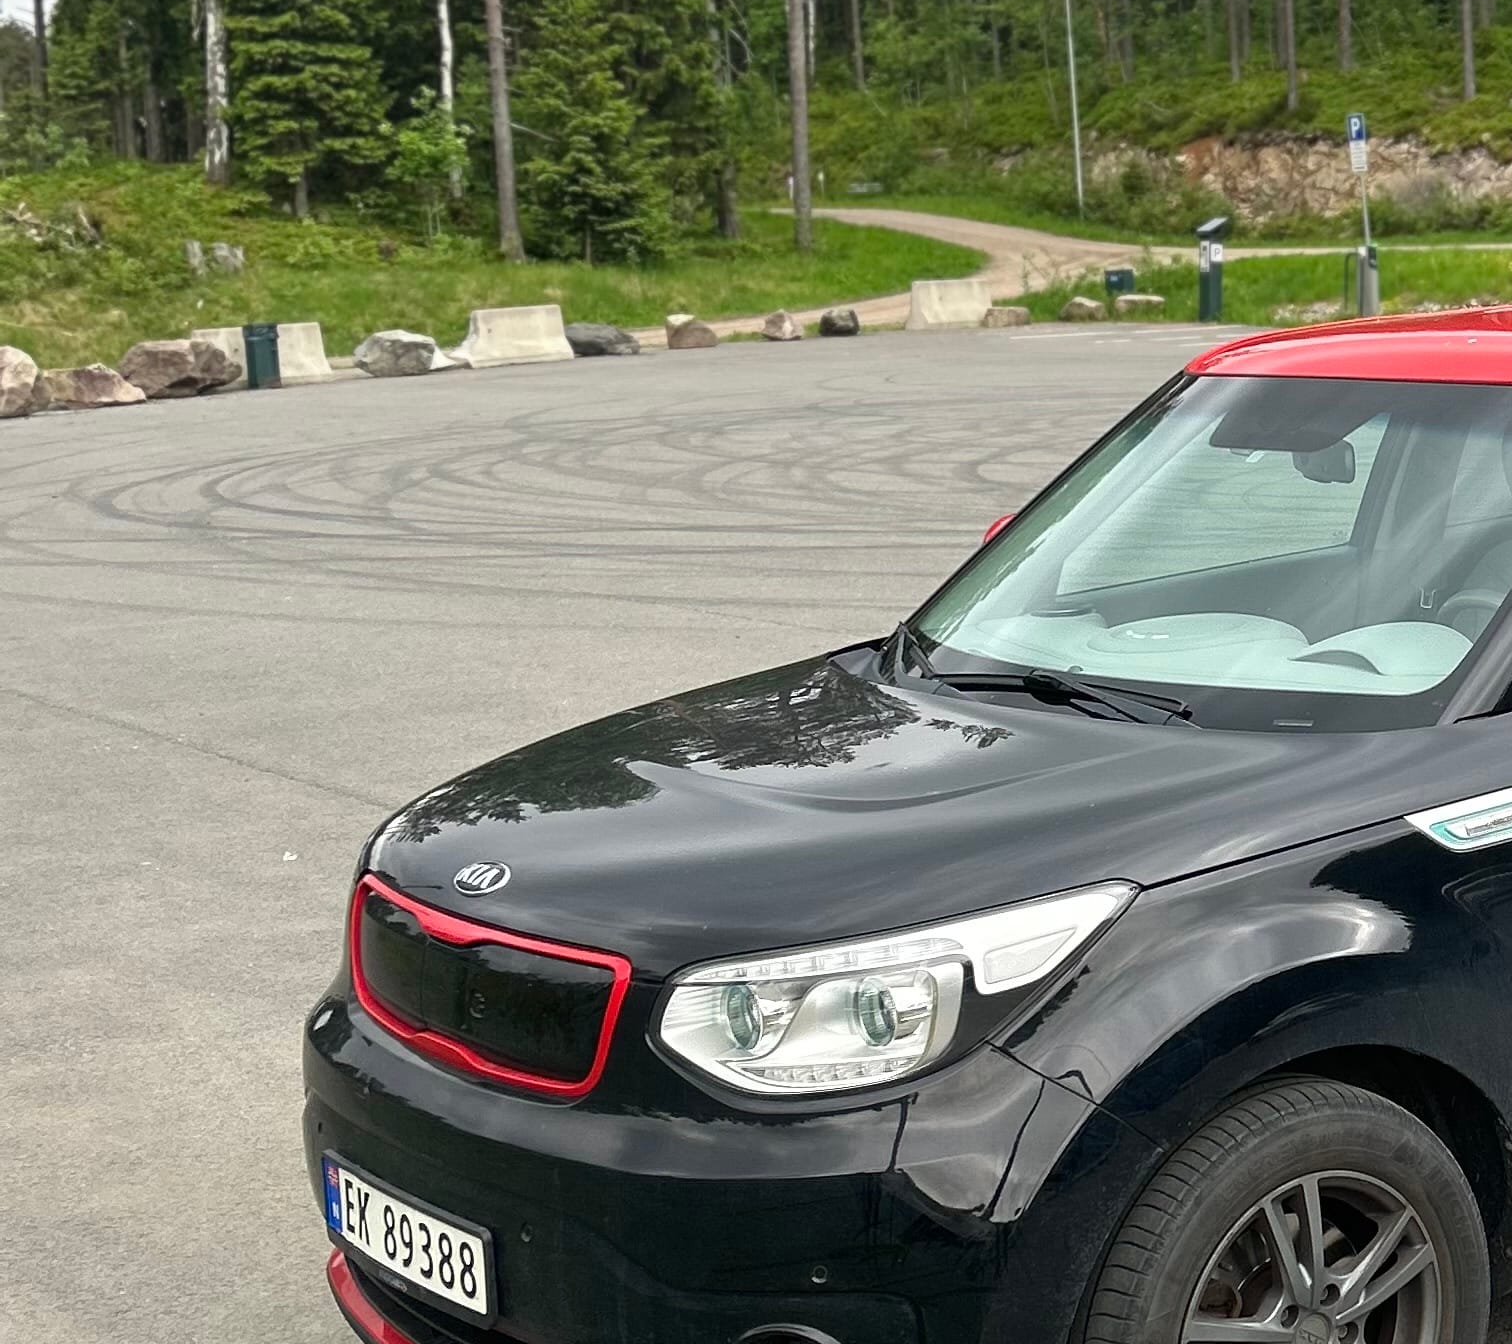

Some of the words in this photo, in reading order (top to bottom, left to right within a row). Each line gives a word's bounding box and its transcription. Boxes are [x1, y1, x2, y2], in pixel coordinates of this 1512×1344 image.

[1350, 118, 1361, 139] P
[1214, 247, 1222, 259] P
[456, 863, 501, 889] KIA
[332, 1201, 340, 1220] N
[345, 1178, 370, 1246] EK
[384, 1204, 477, 1299] 89388
